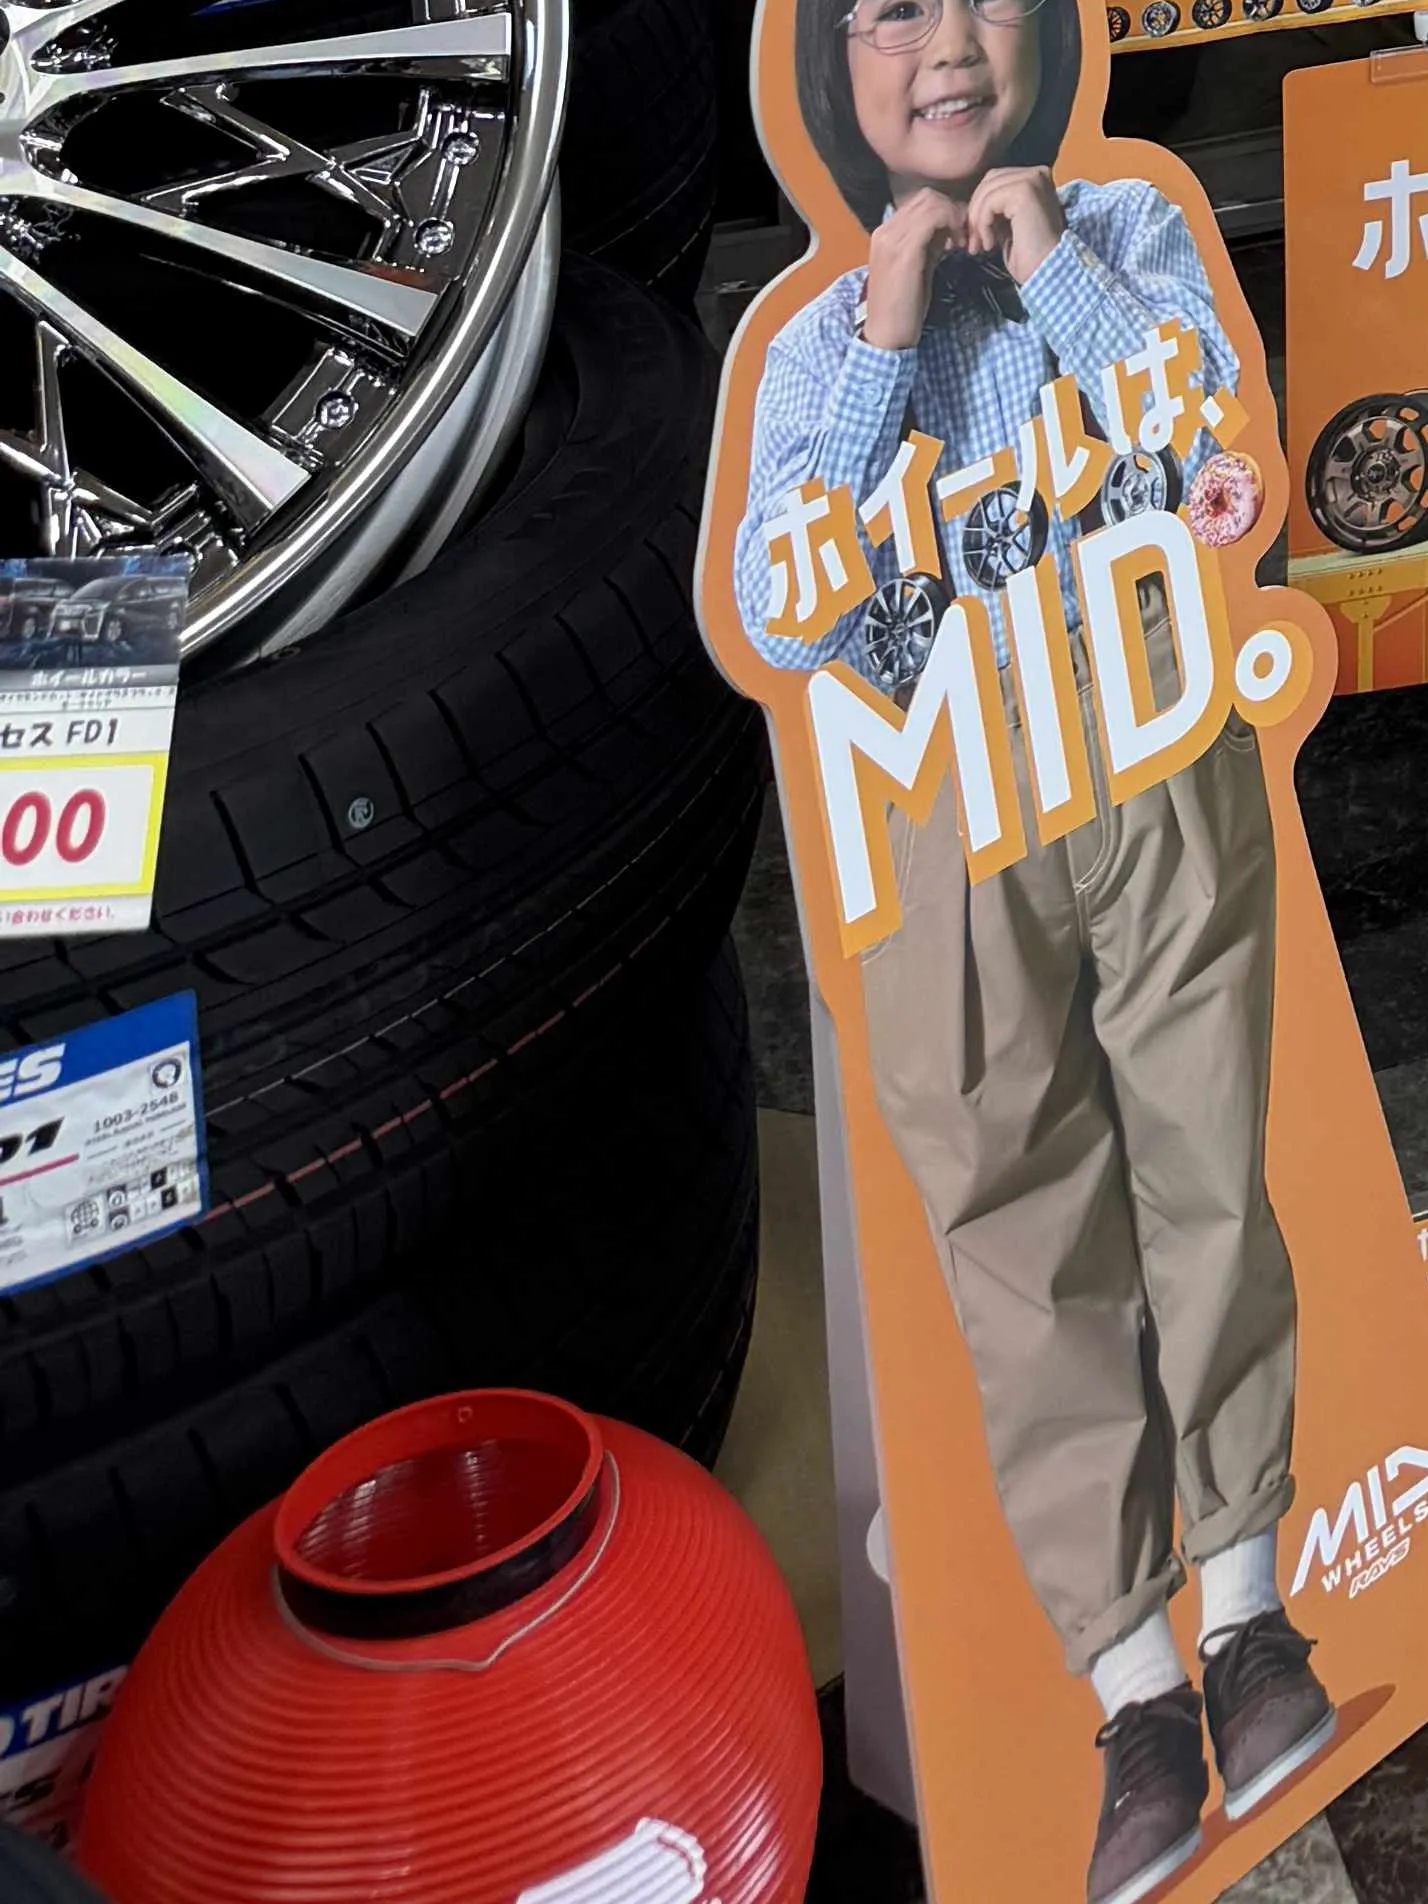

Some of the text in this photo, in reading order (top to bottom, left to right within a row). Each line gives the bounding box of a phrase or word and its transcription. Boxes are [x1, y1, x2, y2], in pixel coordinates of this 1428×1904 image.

[765, 323, 1228, 624] ホイールは、
[66, 718, 118, 746] FD1
[807, 506, 1295, 925] MID。
[1348, 1536, 1412, 1599] RAYS
